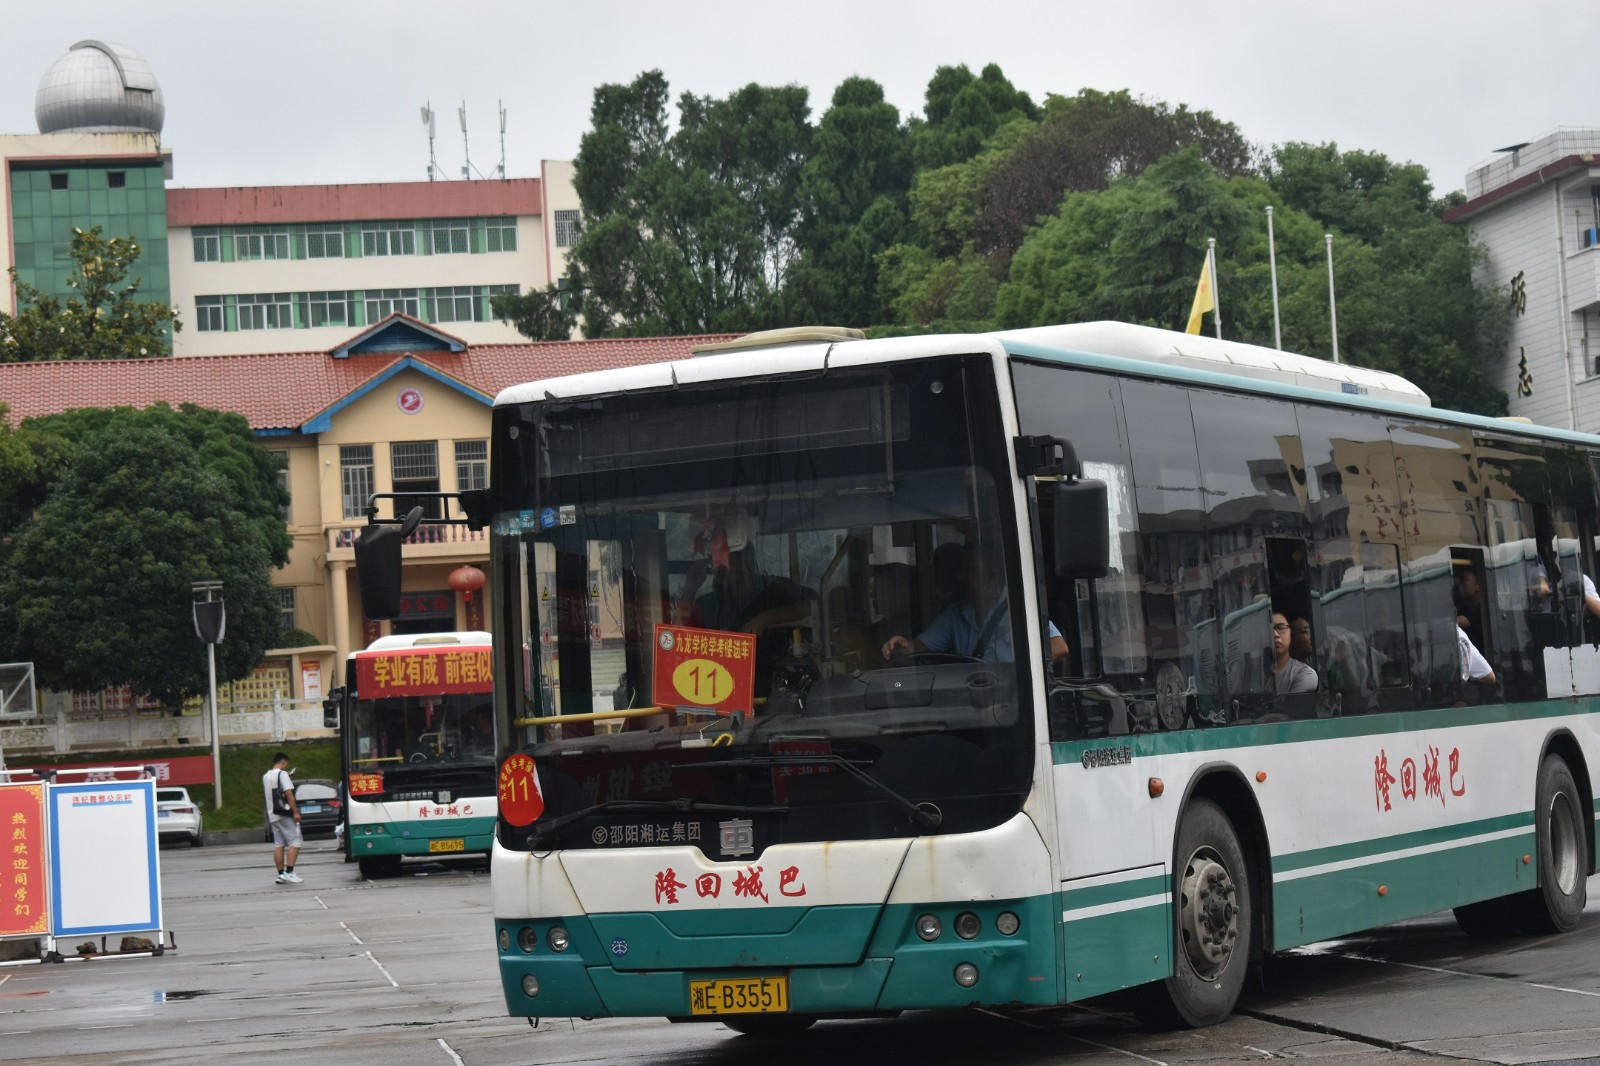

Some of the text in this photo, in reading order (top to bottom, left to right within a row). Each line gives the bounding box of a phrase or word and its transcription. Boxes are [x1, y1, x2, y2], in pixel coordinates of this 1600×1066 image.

[676, 633, 750, 660] 九龙学校学考接送车
[374, 652, 439, 688] 学业有成
[689, 666, 717, 698] 11
[352, 779, 379, 792] 2号车
[507, 776, 528, 802] 11
[1375, 744, 1465, 813] 隆回城巴
[419, 805, 473, 818] 隆回城巴
[610, 821, 701, 844] 邵阳湘运集团
[12, 812, 30, 916] 热烈欢迎同学们
[655, 865, 807, 905] 隆回城巴
